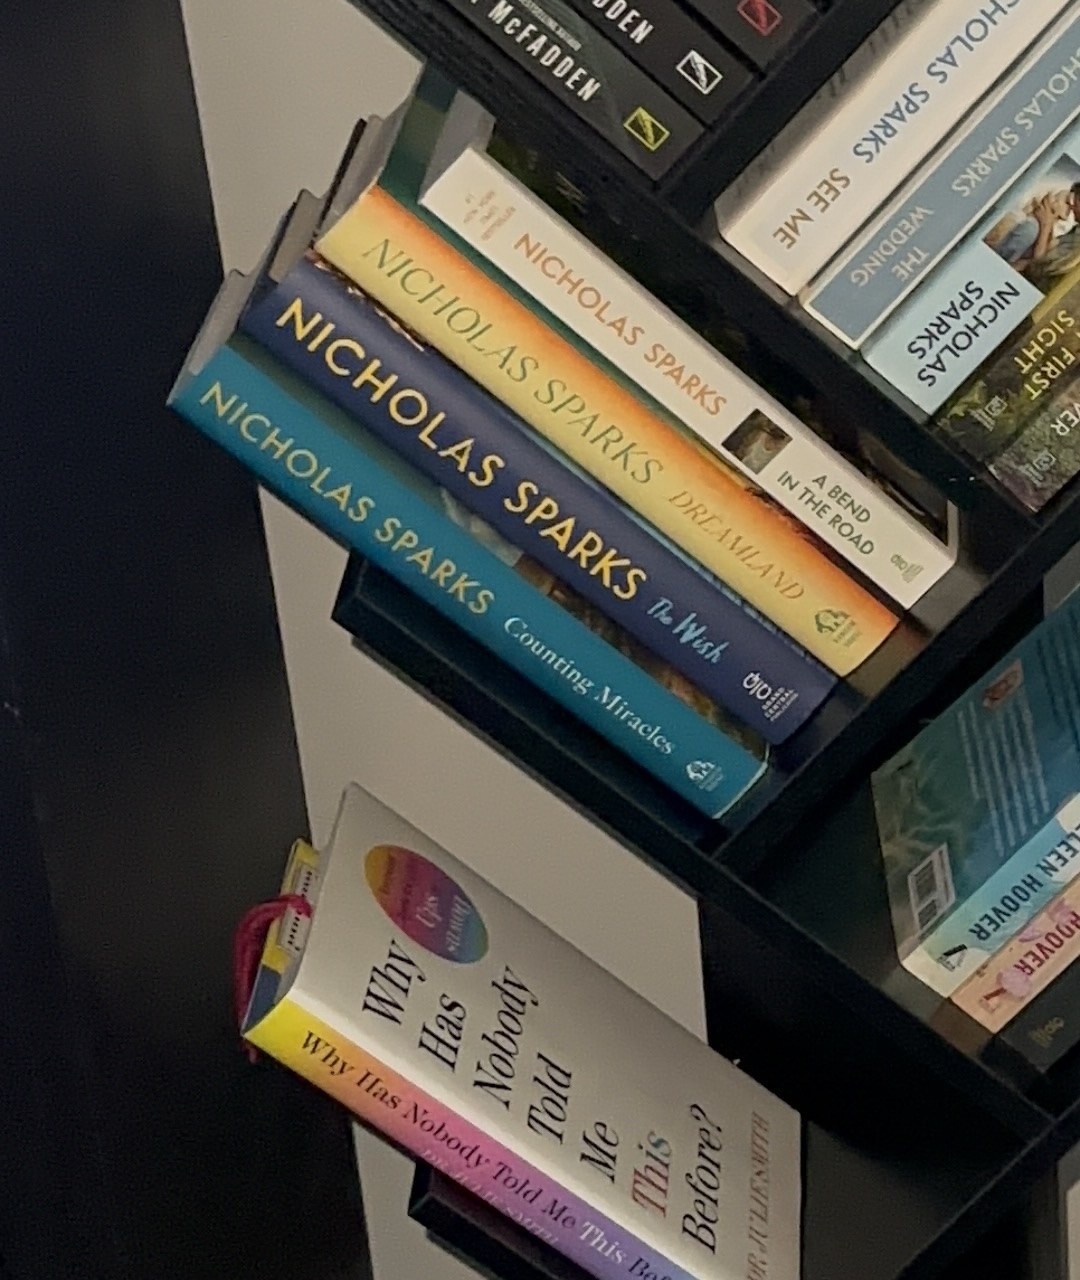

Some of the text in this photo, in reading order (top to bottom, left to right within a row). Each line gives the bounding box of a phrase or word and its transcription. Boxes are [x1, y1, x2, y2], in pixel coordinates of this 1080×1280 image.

[488, 0, 600, 102] McFADDEN
[853, 82, 930, 164] SPARKS
[951, 127, 1021, 197] SPARKS
[772, 168, 851, 250] SEE ME
[851, 205, 935, 287] WEDDING
[891, 245, 931, 283] THE
[513, 232, 727, 417] NICHOLAS SPARKS
[907, 280, 984, 360] SPARKS
[917, 282, 1020, 388] NICHOLAS
[1013, 310, 1075, 375] SIGHT
[1023, 348, 1076, 401] FIRST
[360, 236, 805, 600] NICHOLAS SPARKS DREAMLAND
[275, 296, 729, 665] NICHOLAS SPARKS The Wish
[777, 470, 876, 556] IN THE ROAD
[812, 475, 871, 524] A BEND
[199, 381, 675, 756] NICHOLAS SPARKS Counting Miracles
[968, 874, 1044, 942] HOOVER
[362, 939, 426, 1026] Why
[418, 993, 467, 1073] Has
[473, 965, 539, 1111] Nobody
[527, 1052, 572, 1145] Told
[301, 1030, 355, 1077] Why
[356, 1069, 402, 1110] Has
[402, 1103, 490, 1168] Nobody
[492, 1161, 543, 1204] Told
[542, 1198, 576, 1230] Me
[579, 1221, 629, 1264] This
[580, 1121, 620, 1184] Me
[632, 1131, 671, 1218] This
[682, 1103, 723, 1254] Before?
[752, 1110, 769, 1182] SMITH
